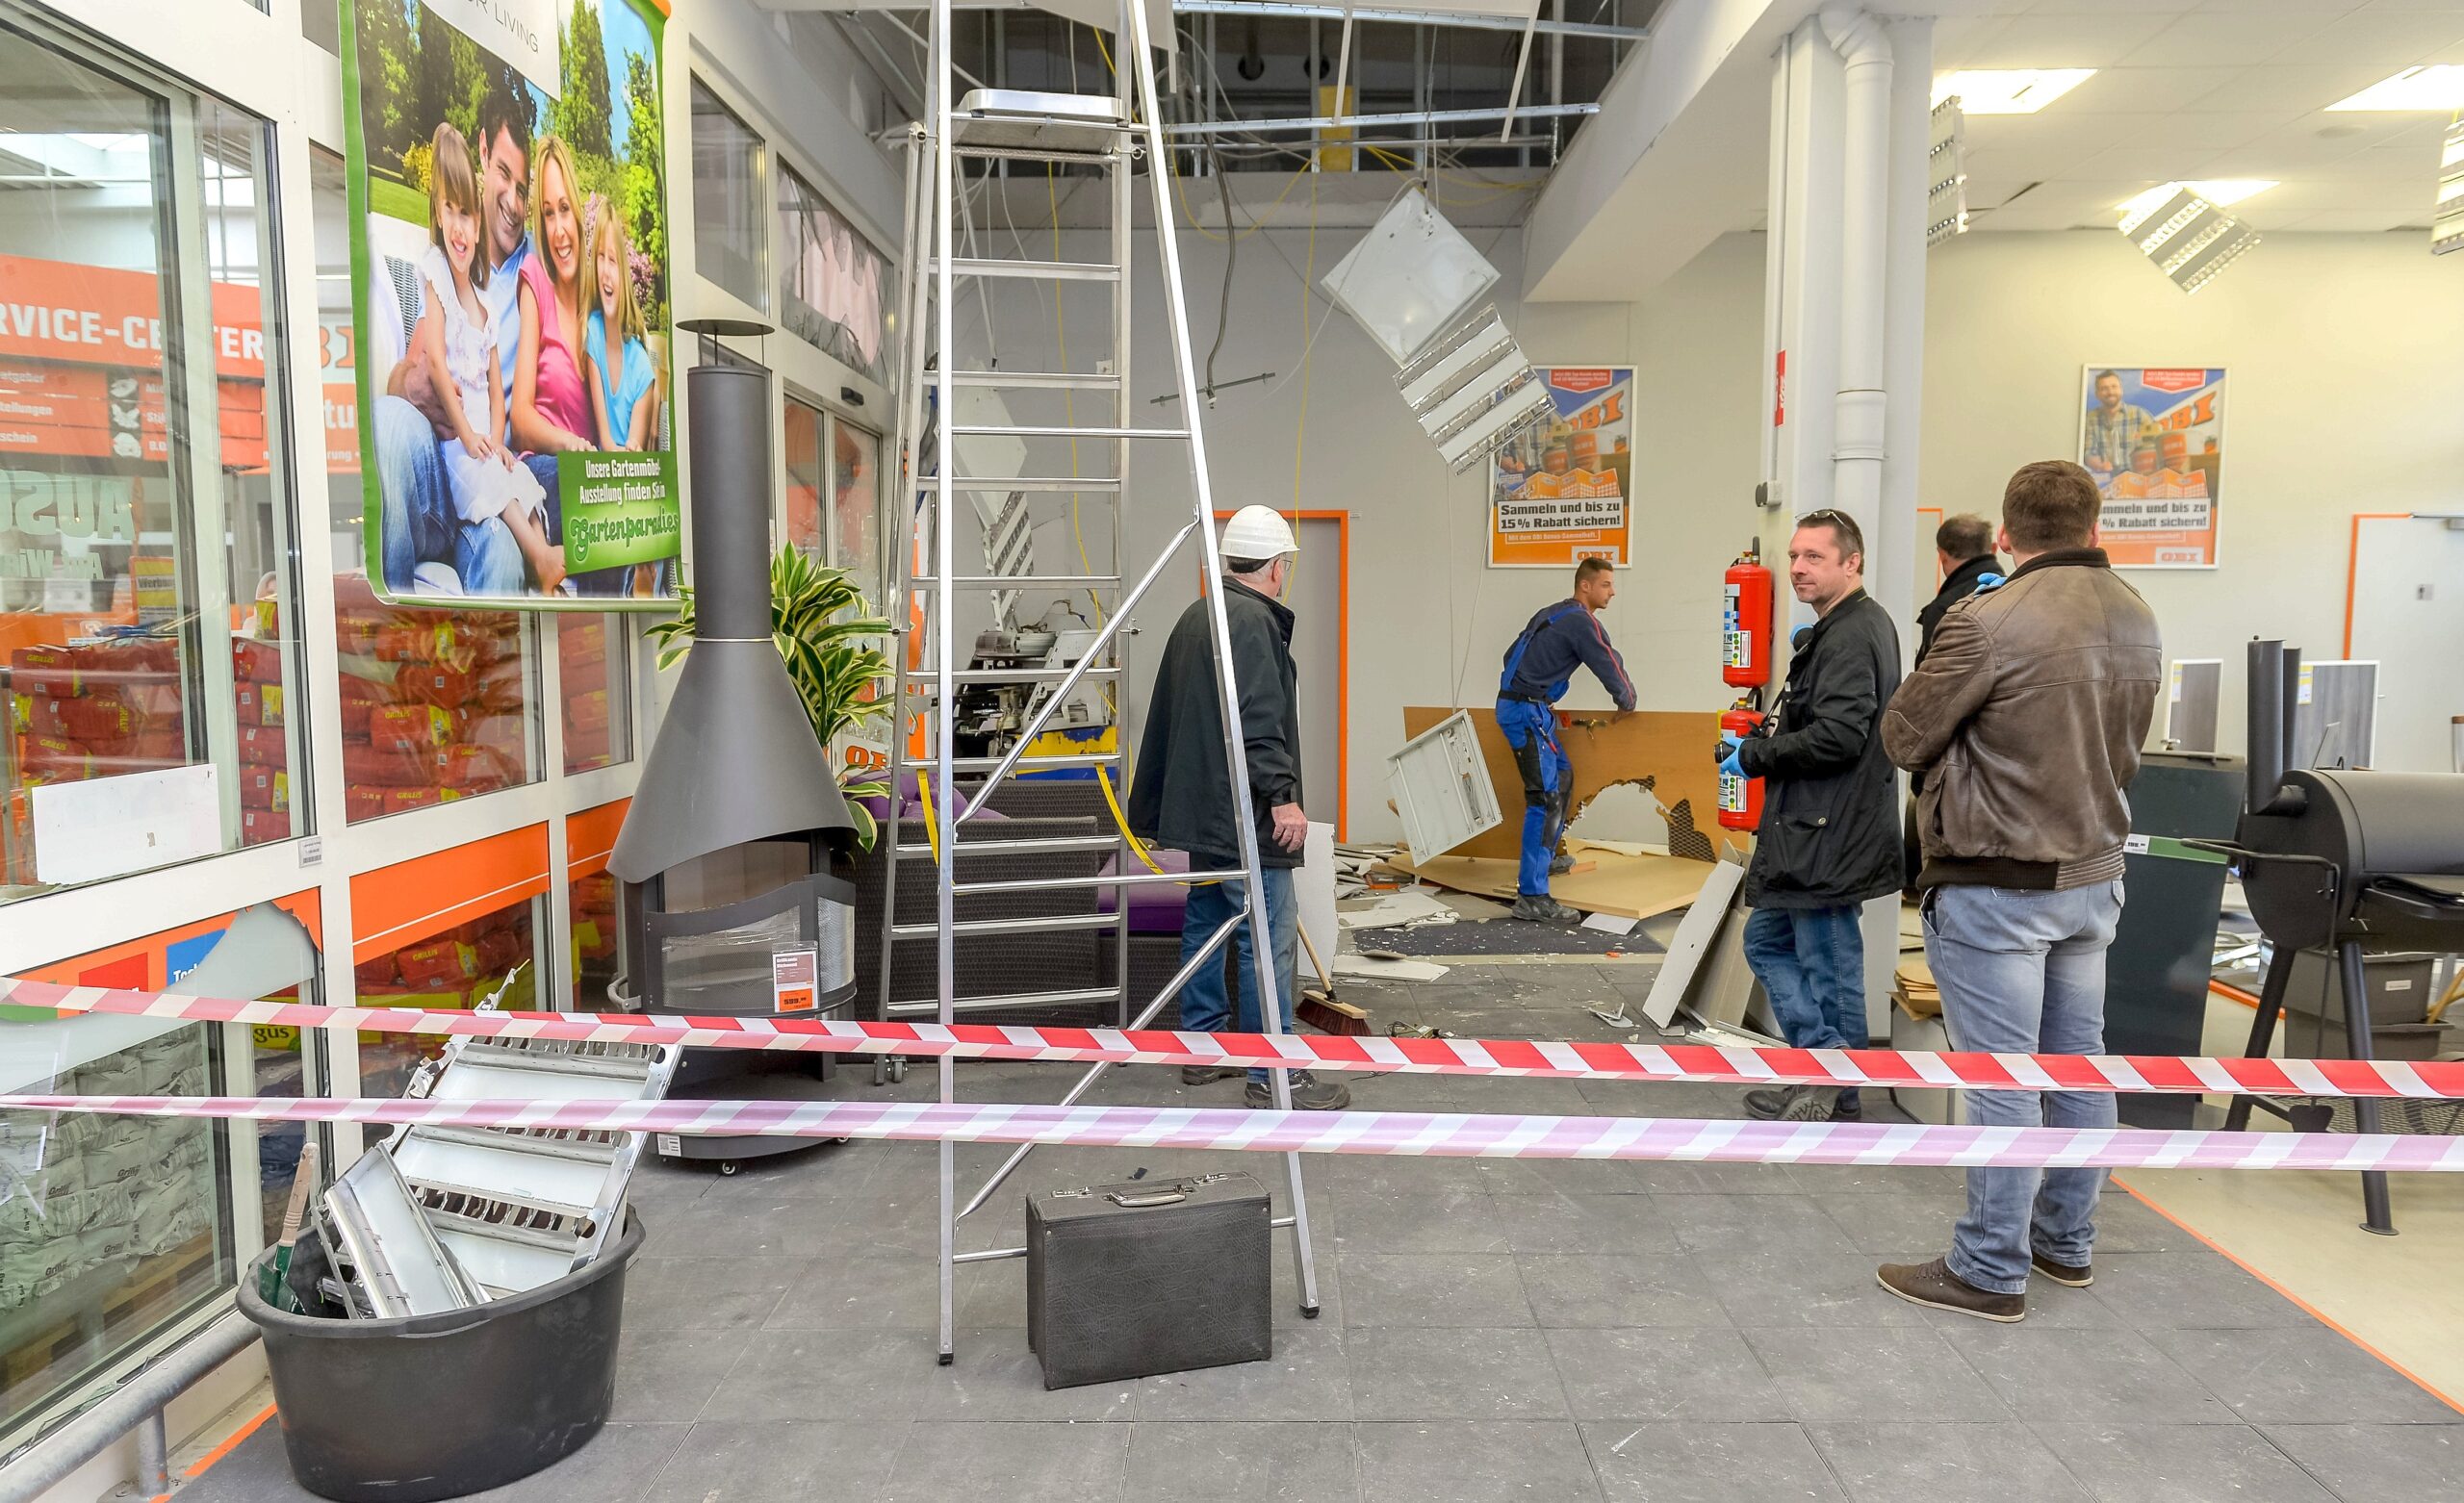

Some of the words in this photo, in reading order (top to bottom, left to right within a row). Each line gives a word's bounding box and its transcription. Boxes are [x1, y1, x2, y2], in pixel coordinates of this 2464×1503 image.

[494, 2, 539, 53] LIVING
[585, 459, 610, 478] Unsere
[579, 484, 622, 505] Ausstellung
[624, 482, 652, 500] finden
[1501, 503, 1556, 516] Sammeln
[1560, 502, 1581, 513] und
[1585, 501, 1603, 512] bis
[1606, 502, 1620, 511] zu
[2100, 503, 2143, 514] mmeln
[2146, 502, 2169, 513] und
[2171, 502, 2189, 513] bis
[2194, 503, 2207, 512] zu
[1501, 519, 1516, 529] 15
[1518, 518, 1530, 528] %
[1533, 518, 1571, 528] Rabatt
[1574, 515, 1621, 526] sichern!
[2118, 518, 2157, 528] Rabatt
[2160, 517, 2206, 527] sichern!
[570, 506, 679, 562] Gartenparadies
